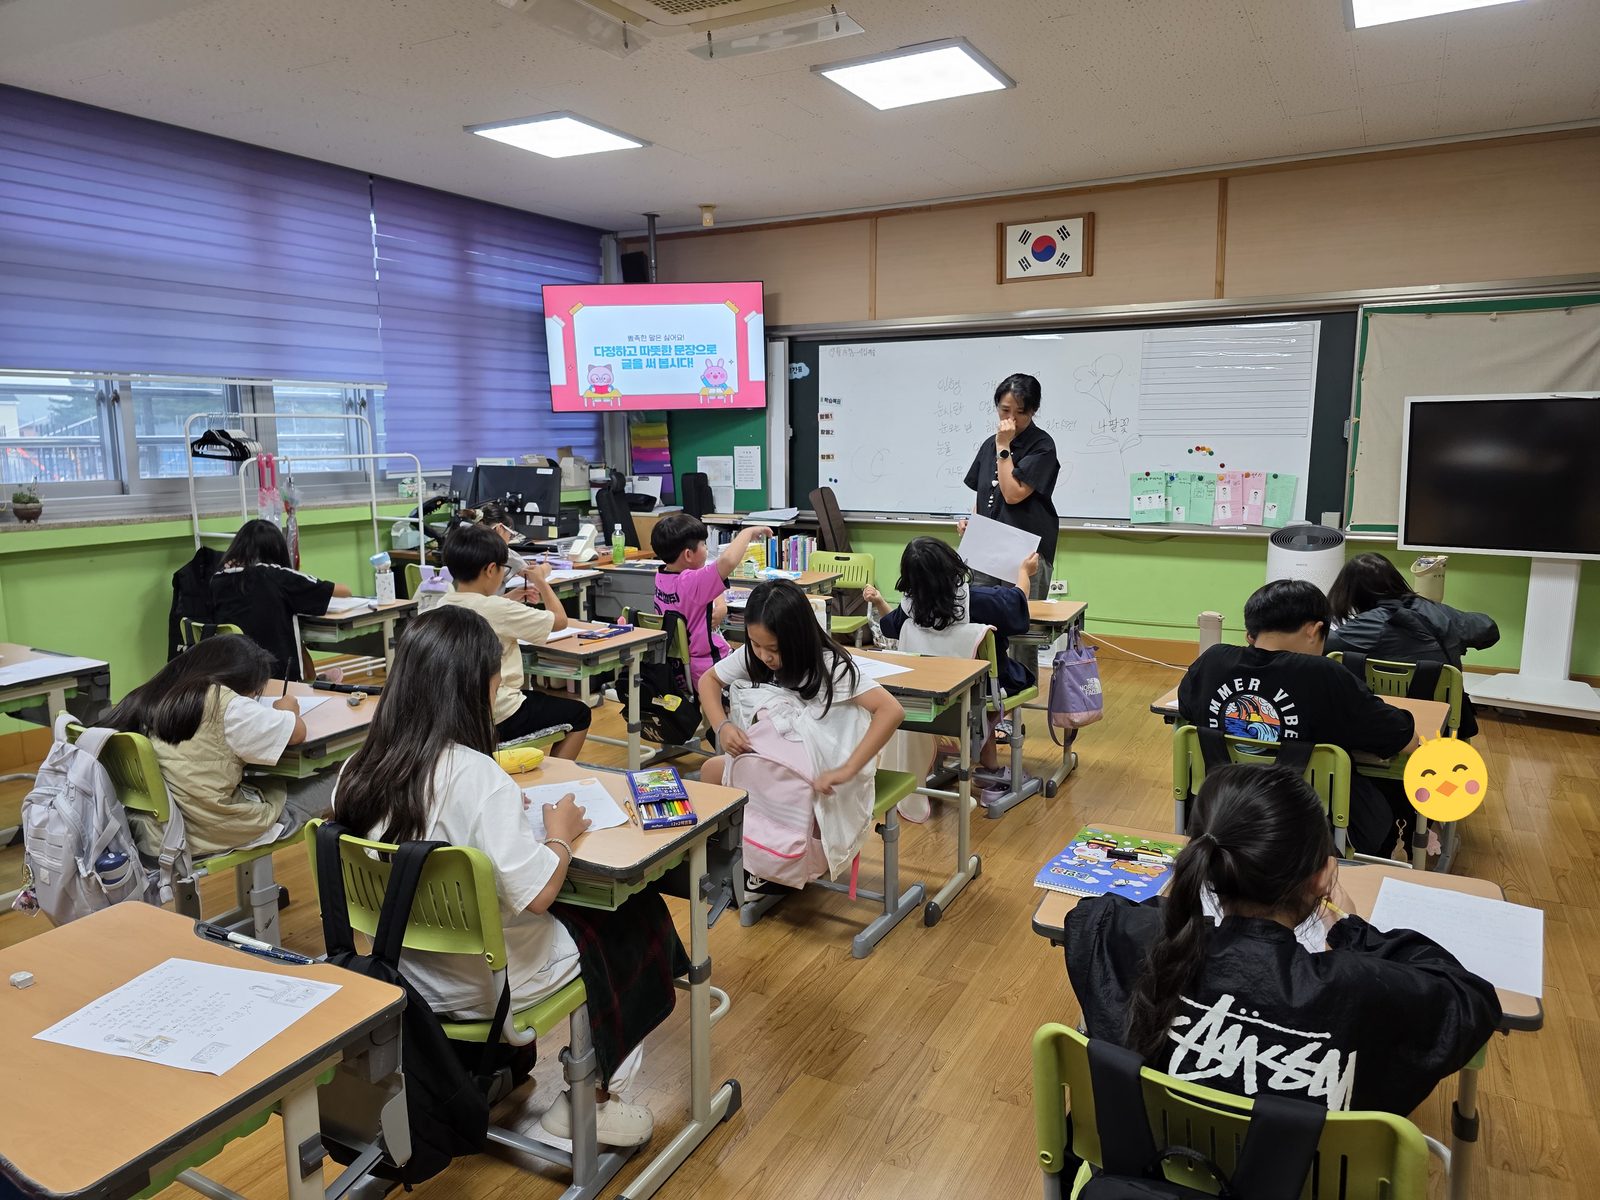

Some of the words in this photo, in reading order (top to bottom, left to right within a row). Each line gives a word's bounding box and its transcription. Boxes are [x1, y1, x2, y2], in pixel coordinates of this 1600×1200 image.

[594, 344, 638, 358] 다정하고
[639, 344, 672, 357] 따뜻한
[674, 343, 718, 356] 문장으로
[621, 358, 643, 370] 글을
[645, 357, 656, 369] 써
[659, 357, 694, 369] 봅시다!
[1209, 677, 1261, 729] UMMER
